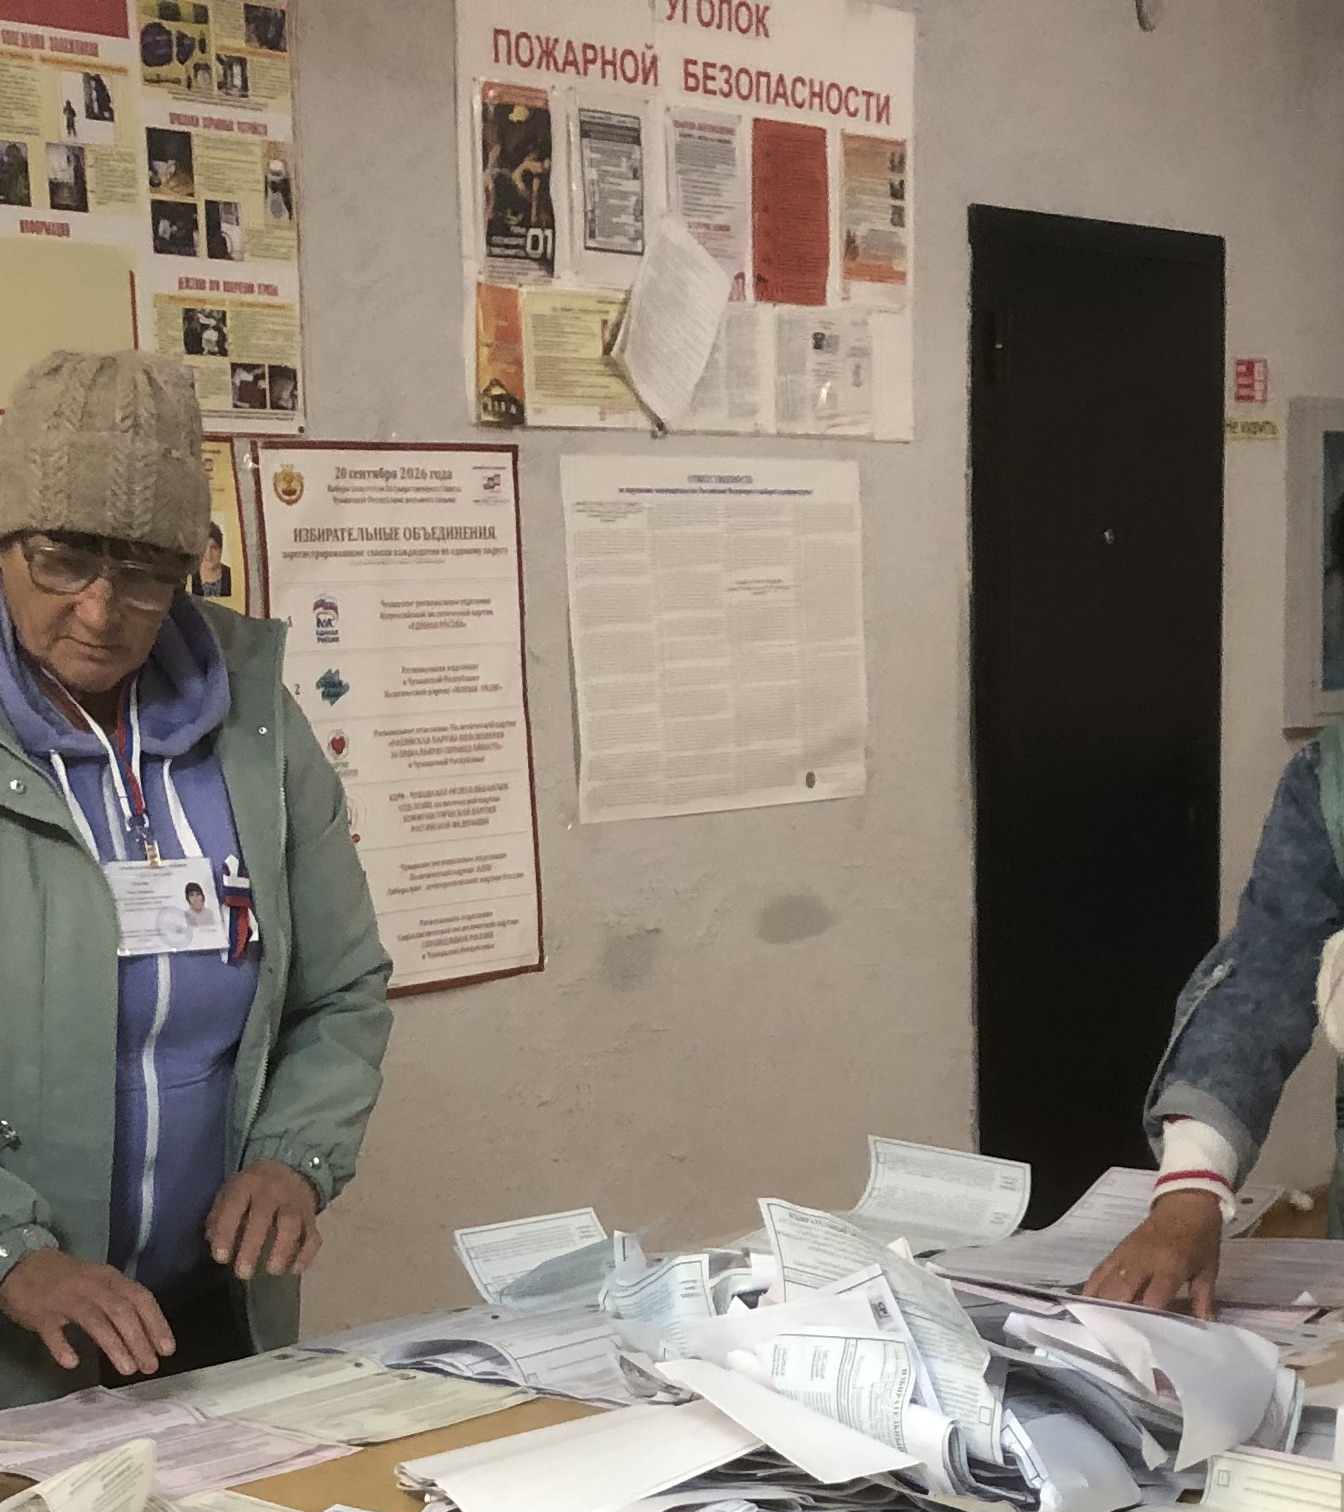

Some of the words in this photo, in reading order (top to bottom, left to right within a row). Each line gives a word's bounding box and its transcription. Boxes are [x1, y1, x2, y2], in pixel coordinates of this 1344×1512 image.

[666, 0, 770, 38] УГОЛОК
[492, 28, 659, 87] ПОЖАРНОЙ
[683, 57, 891, 126] БЕЗОПАСНОСТИ
[526, 227, 553, 259] 01
[334, 466, 347, 480] 20
[349, 466, 398, 482] сентября
[293, 527, 401, 543] ИЗБИРАТЕЛЬНЫЕ
[403, 525, 497, 542] ОБЪЕДИНЕНИЯ
